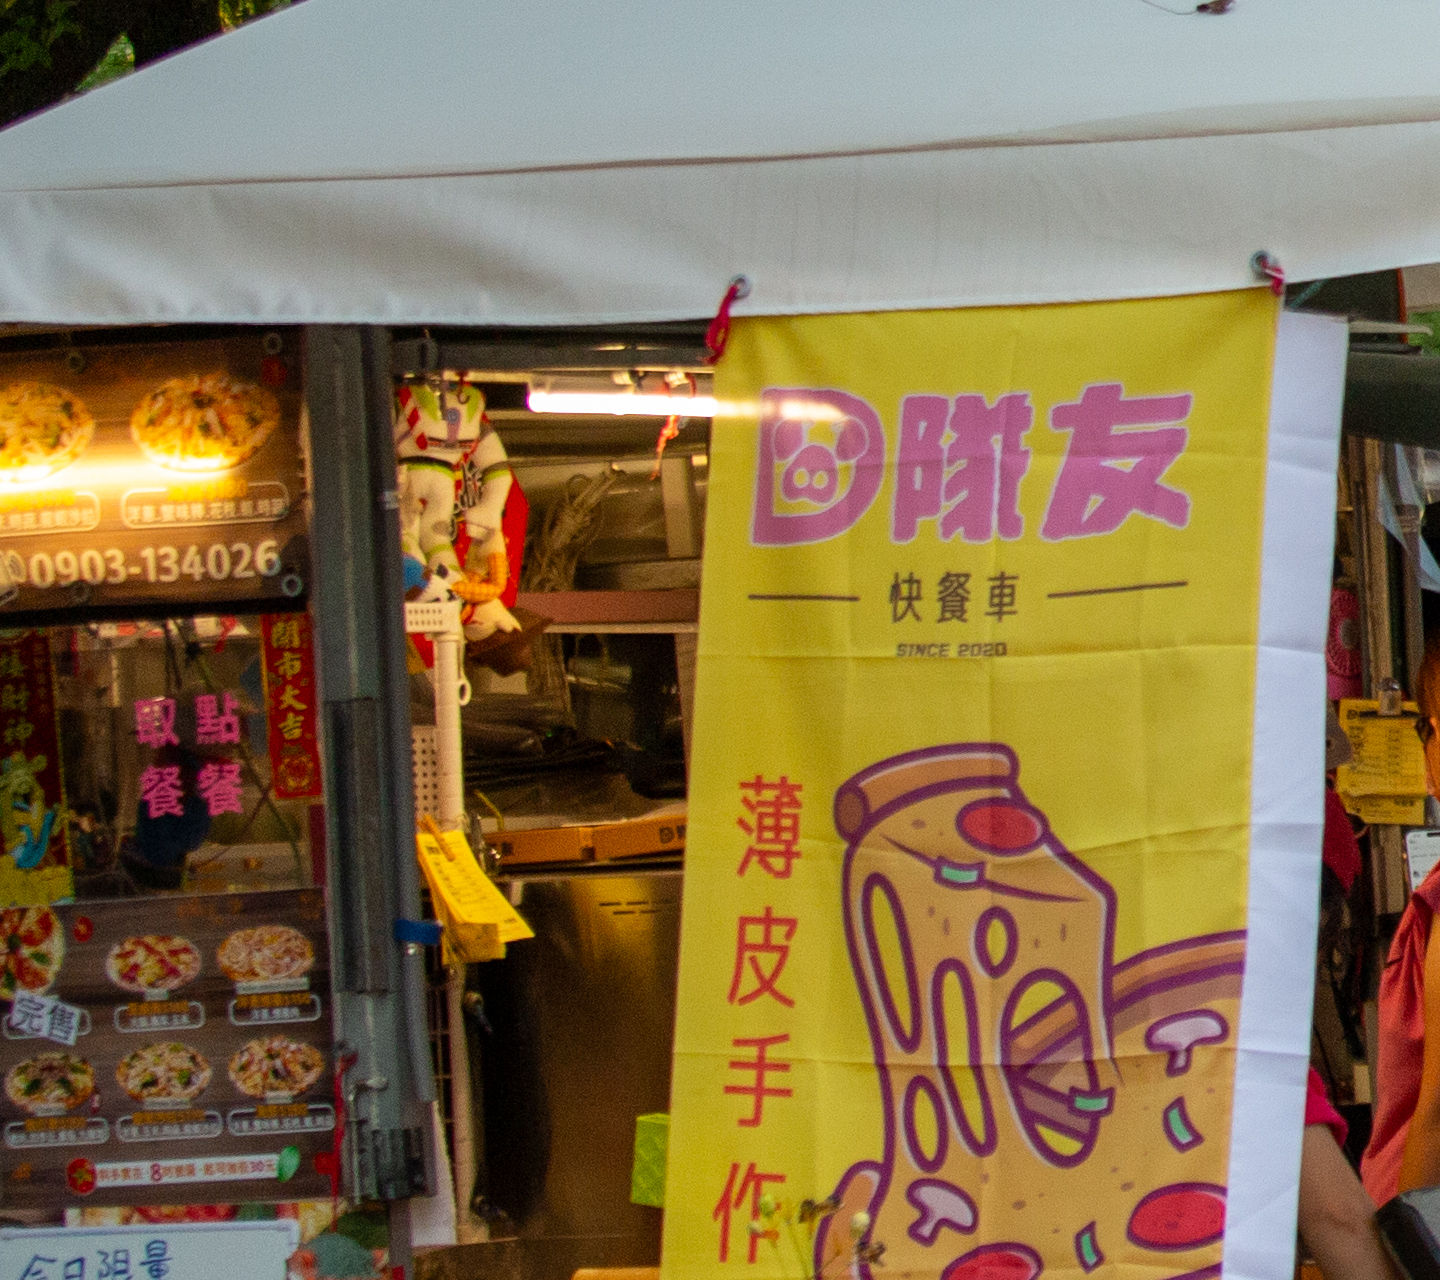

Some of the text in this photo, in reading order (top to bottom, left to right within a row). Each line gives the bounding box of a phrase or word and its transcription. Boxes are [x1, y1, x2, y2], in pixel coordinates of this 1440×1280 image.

[29, 539, 281, 589] 0903-134026
[890, 571, 1020, 624] 快餐車
[896, 641, 1009, 659] SINCE 2020
[134, 694, 185, 819] 取餐
[194, 691, 244, 817] 點餐
